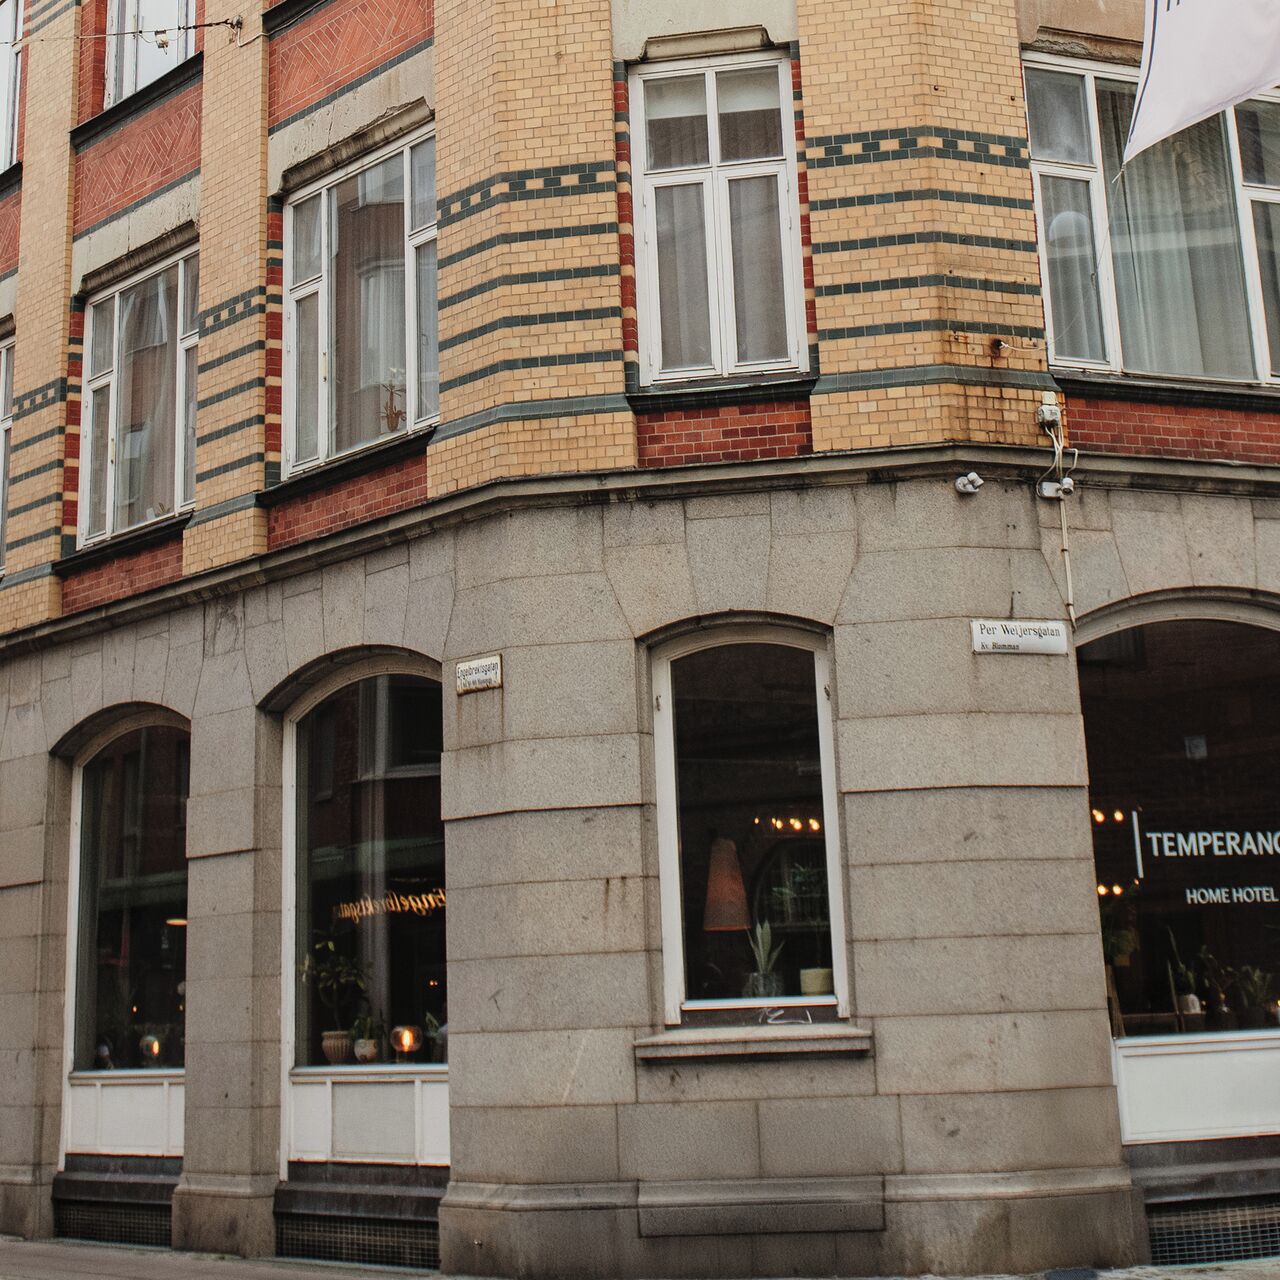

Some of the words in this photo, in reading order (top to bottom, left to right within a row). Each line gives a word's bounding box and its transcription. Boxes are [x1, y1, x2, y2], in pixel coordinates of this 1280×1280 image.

[979, 623, 997, 636] Per
[1000, 623, 1061, 639] Weijersgatan
[1186, 887, 1230, 905] HOME
[1232, 886, 1279, 904] HOTEL
